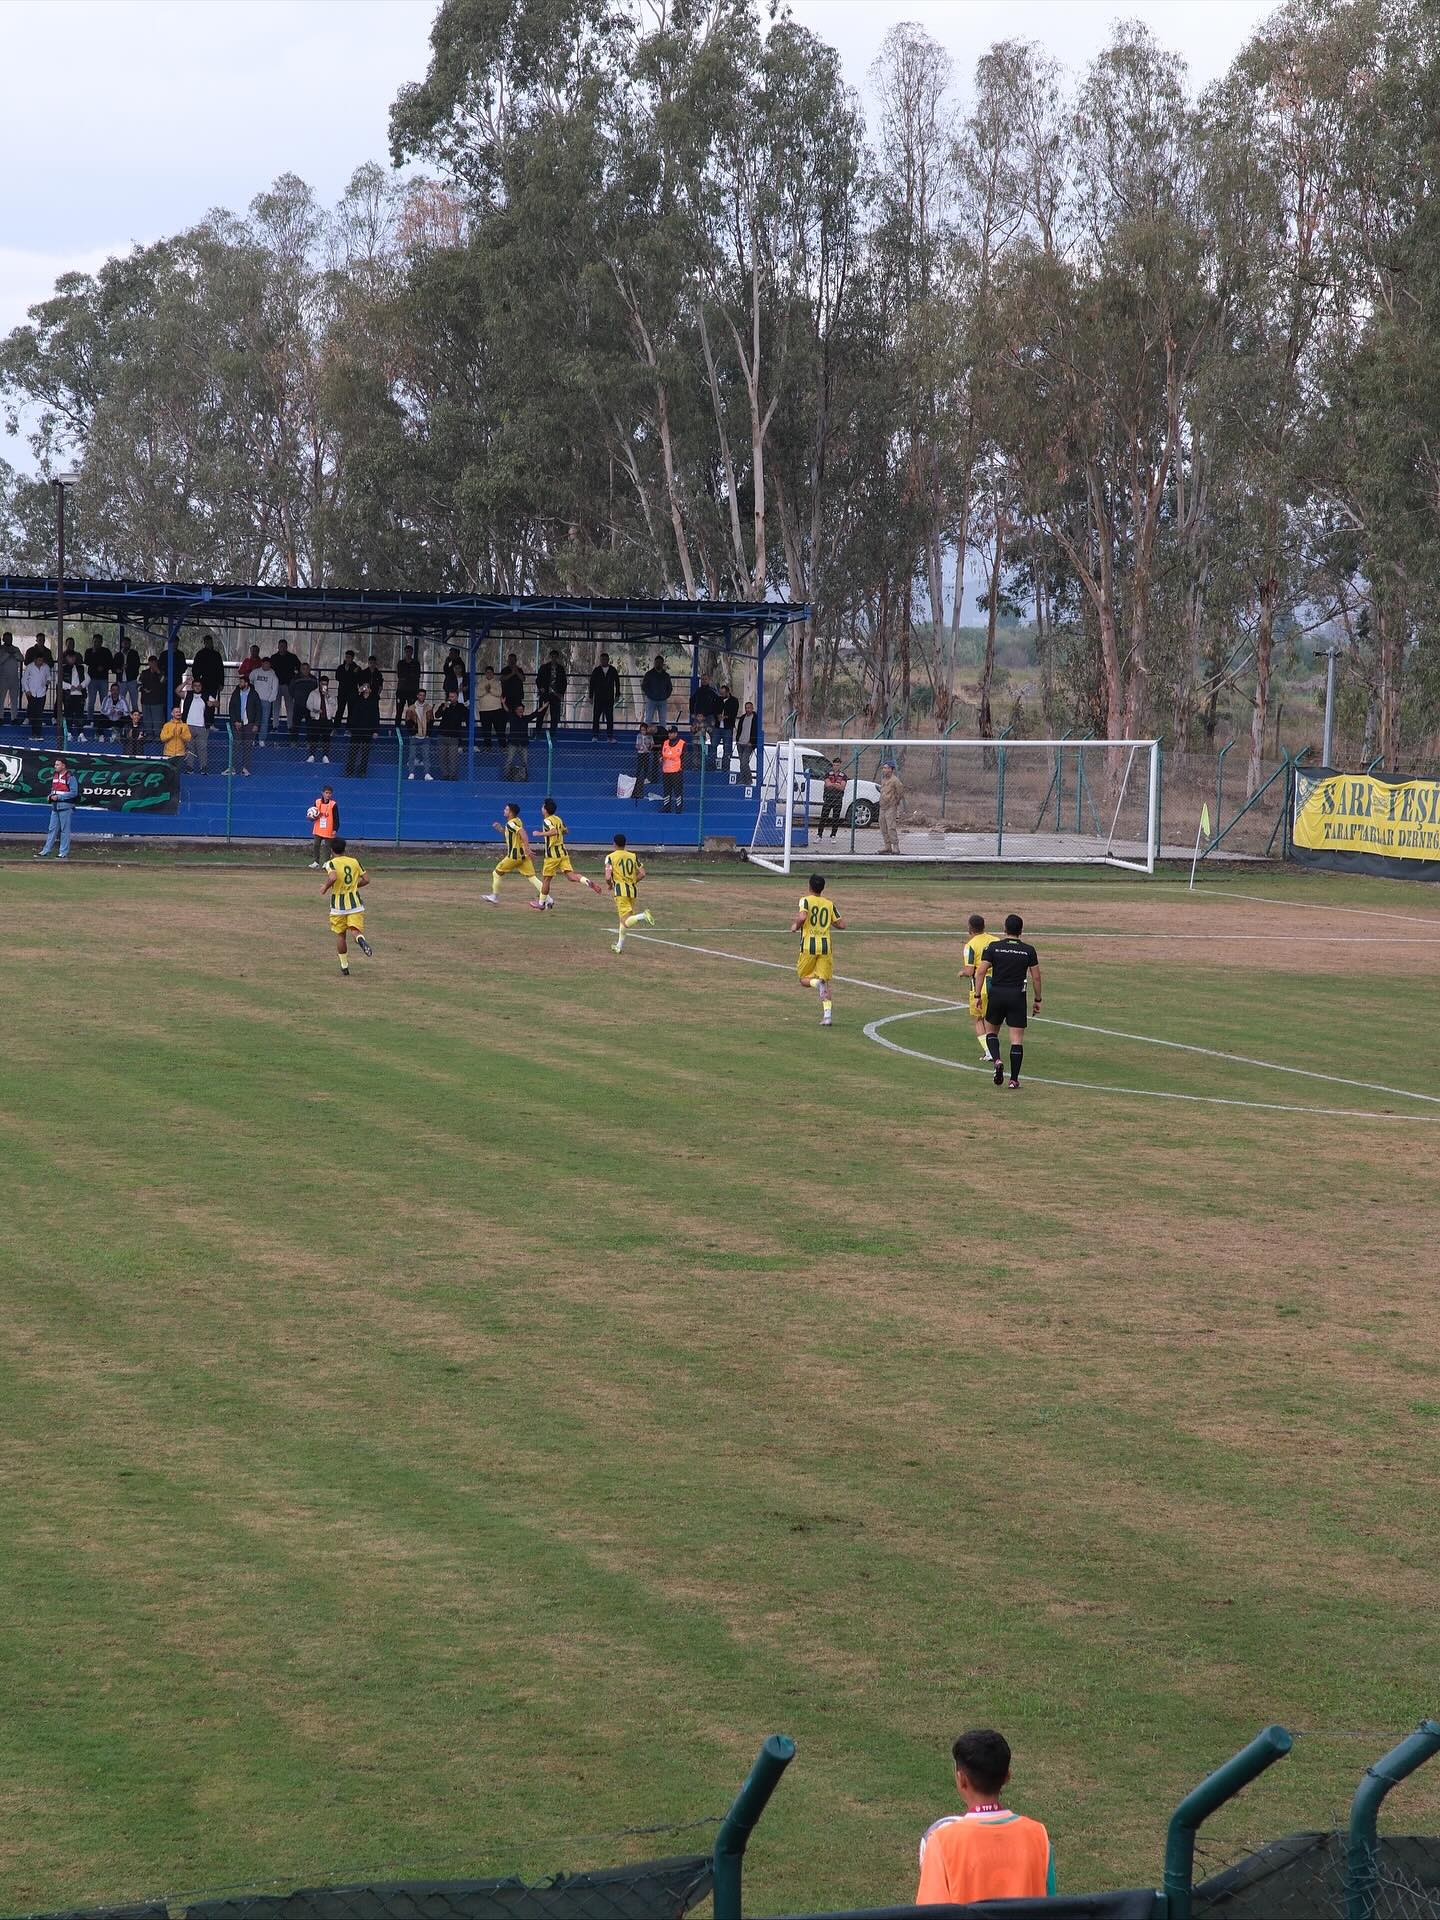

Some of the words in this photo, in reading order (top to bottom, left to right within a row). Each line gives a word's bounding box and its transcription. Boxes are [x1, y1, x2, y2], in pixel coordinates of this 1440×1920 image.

[38, 767, 165, 788] ÇTELER
[1321, 782, 1373, 817] SARI
[1387, 783, 1440, 831] YEŞİ
[1397, 828, 1440, 850] DERNEĞ
[344, 865, 352, 885] 8
[618, 857, 634, 878] 10
[809, 904, 829, 928] 80
